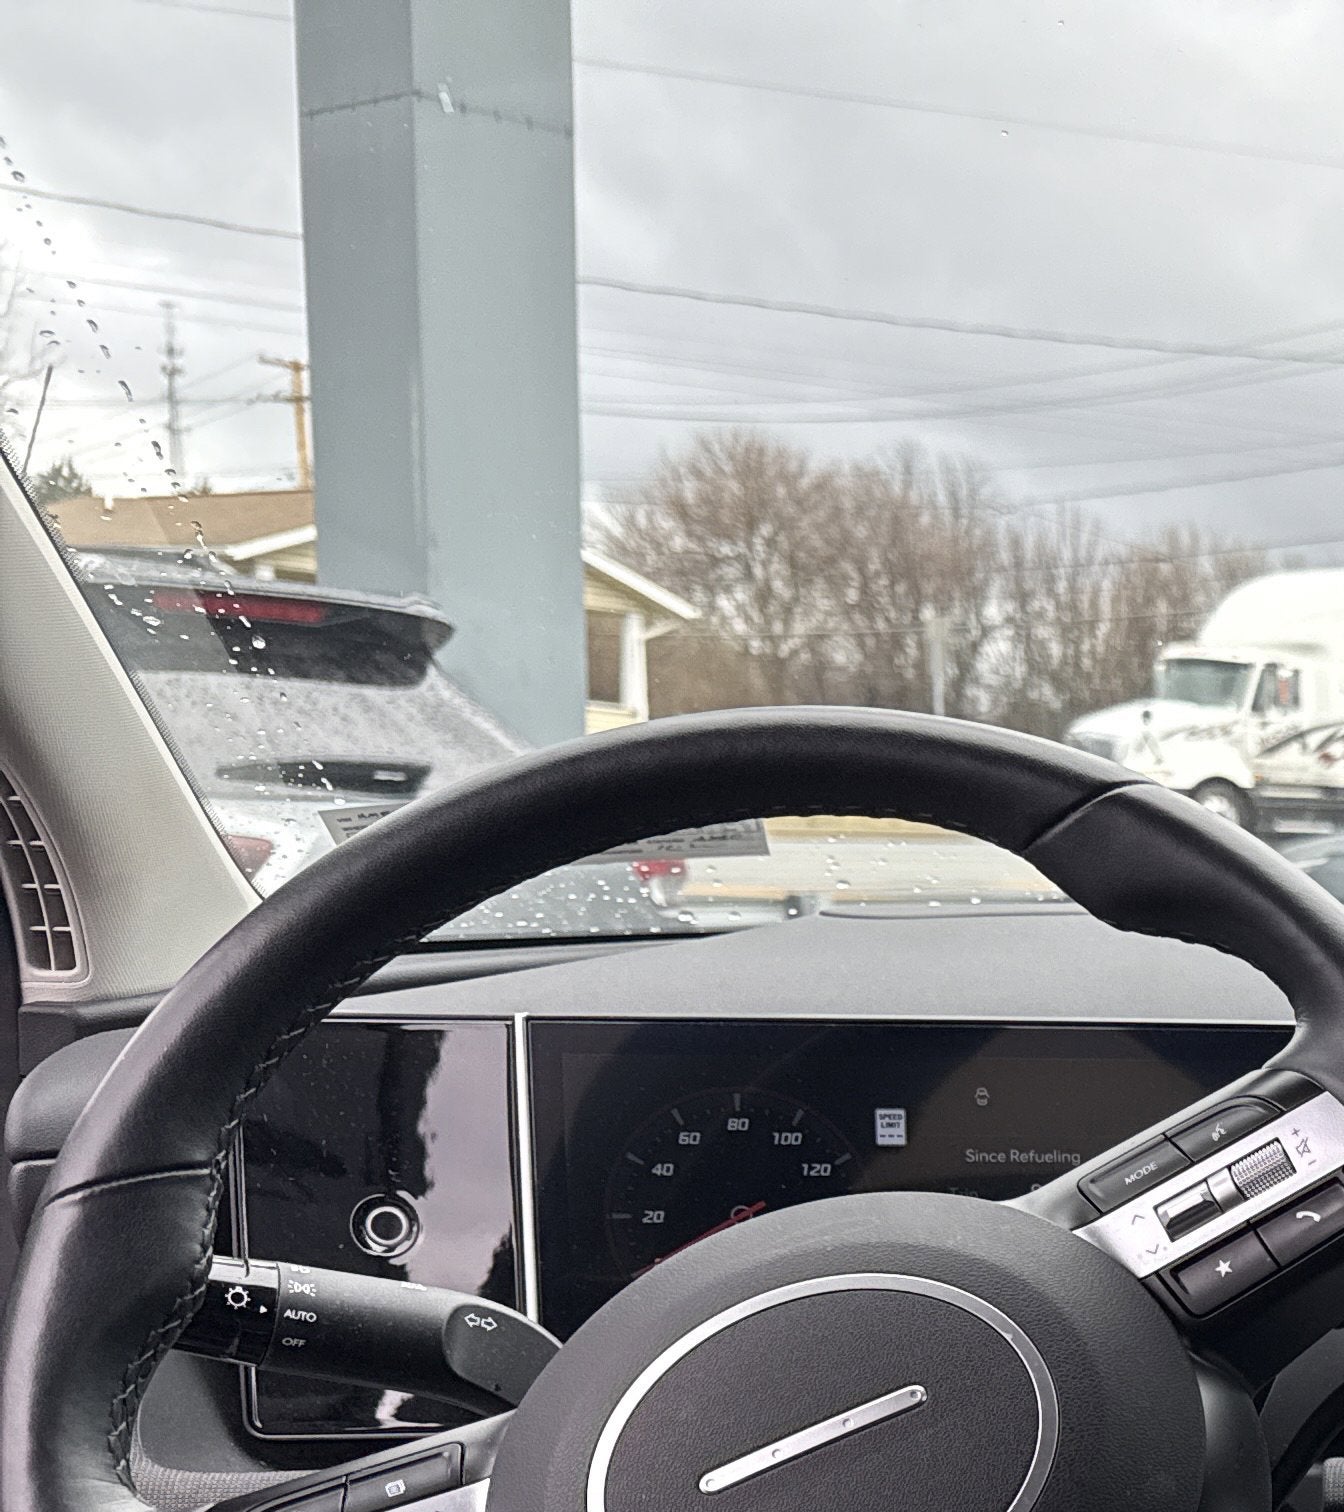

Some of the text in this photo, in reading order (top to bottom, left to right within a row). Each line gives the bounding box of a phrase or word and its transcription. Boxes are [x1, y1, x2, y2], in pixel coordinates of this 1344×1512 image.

[879, 1113, 903, 1121] SPEED
[727, 1118, 750, 1131] 80
[678, 1132, 701, 1145] 60
[772, 1132, 802, 1145] 100
[965, 1149, 1081, 1165] Since Refueling
[651, 1163, 674, 1176] 40
[802, 1163, 832, 1176] 120
[1124, 1161, 1158, 1186] MODE
[641, 1210, 665, 1224] 20
[283, 1308, 317, 1323] AUTO
[281, 1337, 306, 1348] OFF
